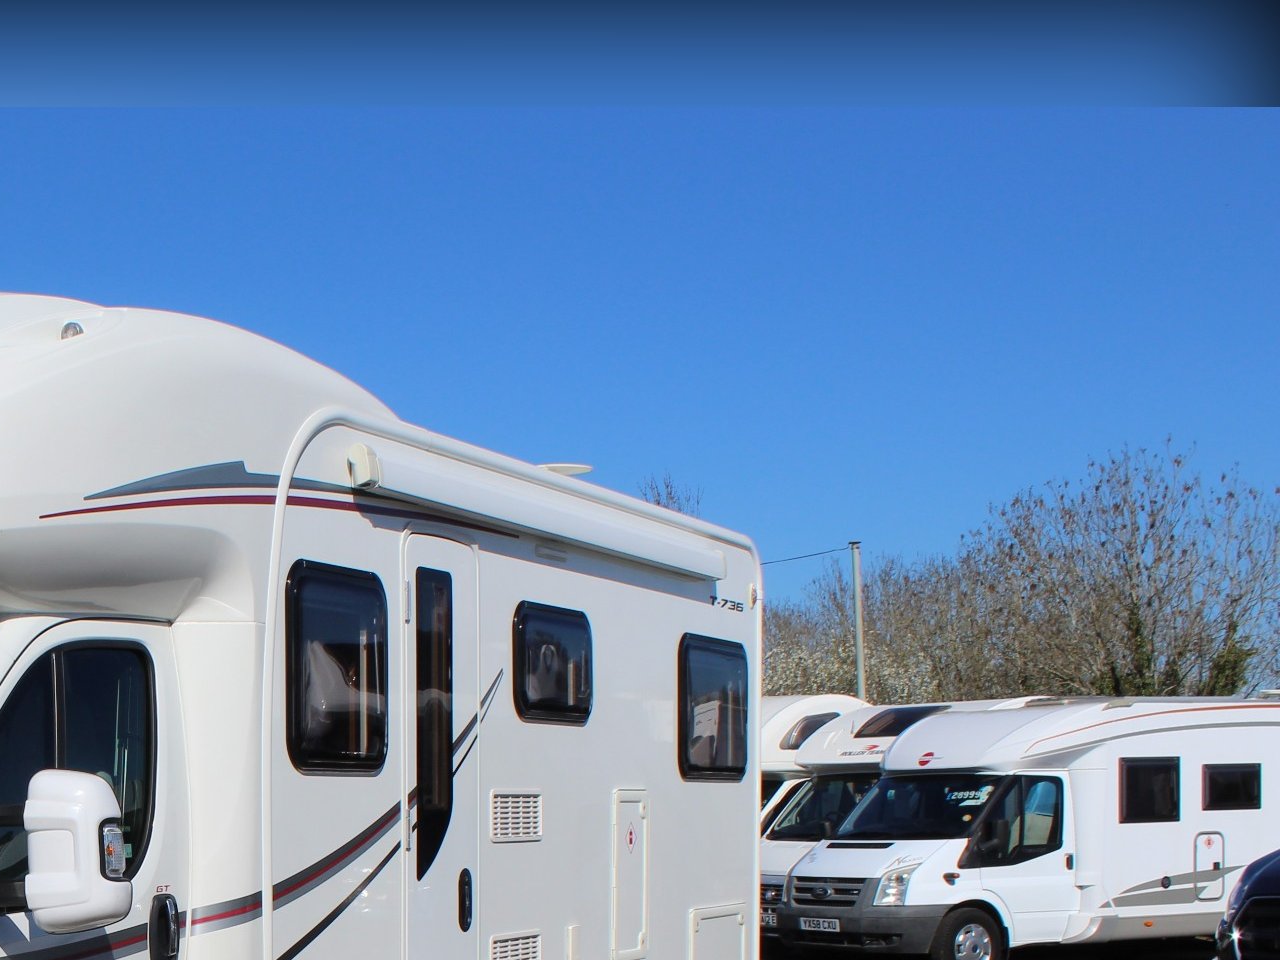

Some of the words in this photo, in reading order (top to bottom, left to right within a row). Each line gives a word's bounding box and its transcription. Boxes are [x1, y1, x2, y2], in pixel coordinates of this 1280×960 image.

[710, 595, 743, 613] T-736
[156, 884, 171, 893] GT
[803, 918, 821, 929] YX58
[822, 920, 838, 930] CXU
